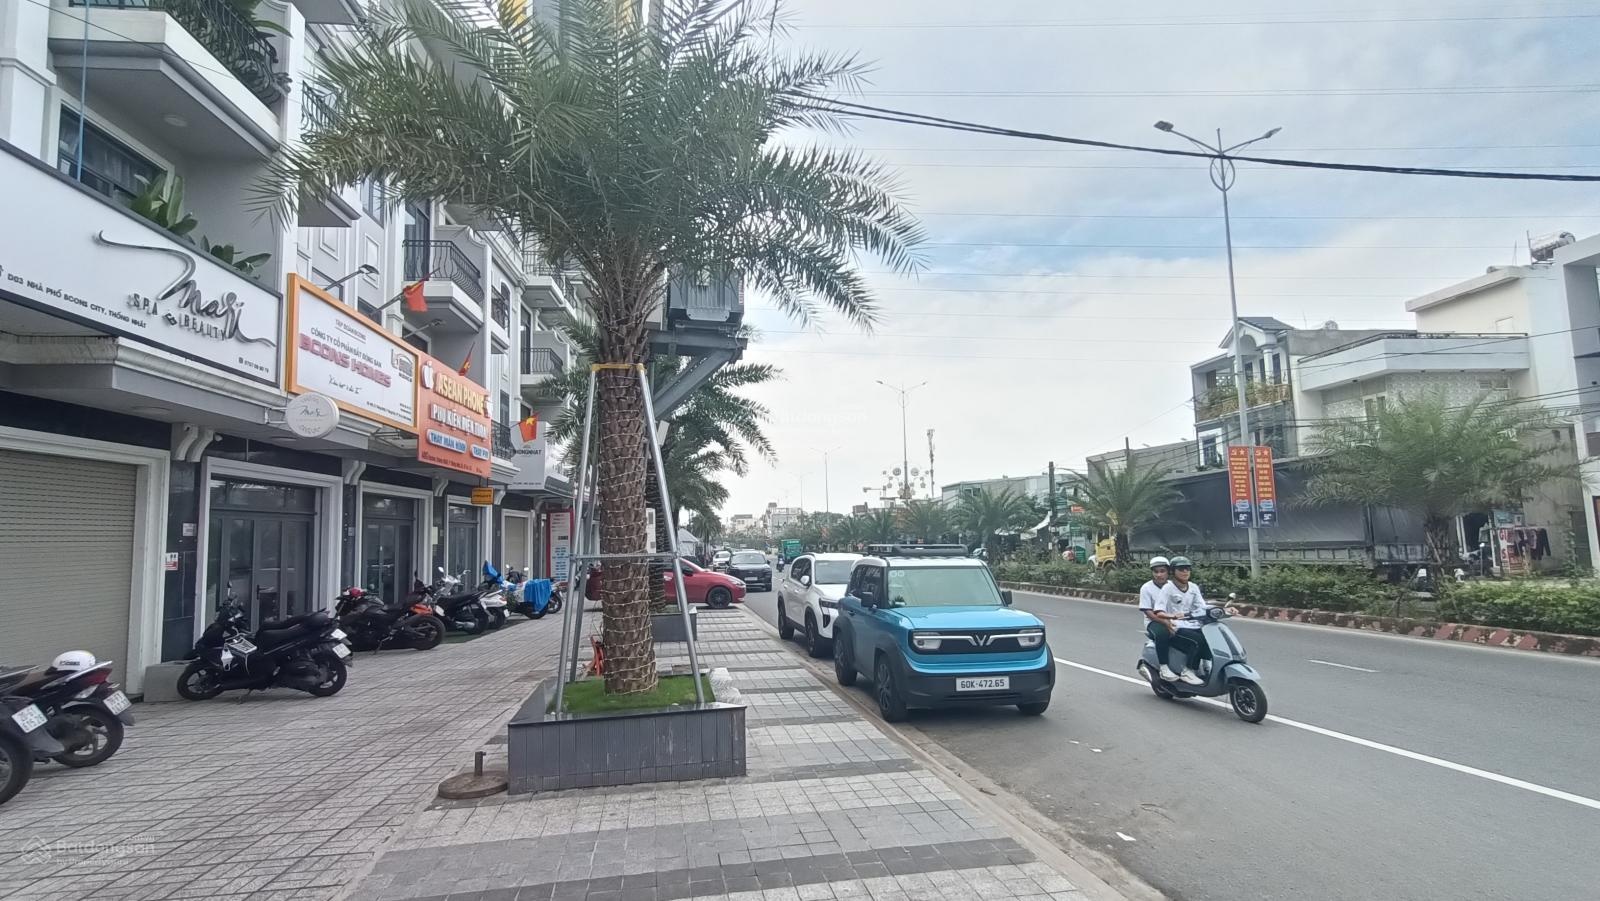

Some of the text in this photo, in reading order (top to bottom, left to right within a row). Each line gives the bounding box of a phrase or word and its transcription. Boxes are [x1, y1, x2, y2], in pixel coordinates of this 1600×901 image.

[64, 294, 88, 308] BCONS
[133, 293, 158, 315] SPA
[184, 314, 226, 341] BEAUTY
[436, 372, 484, 415] ASEAN PHONE
[961, 679, 1004, 689] 60K-472.65
